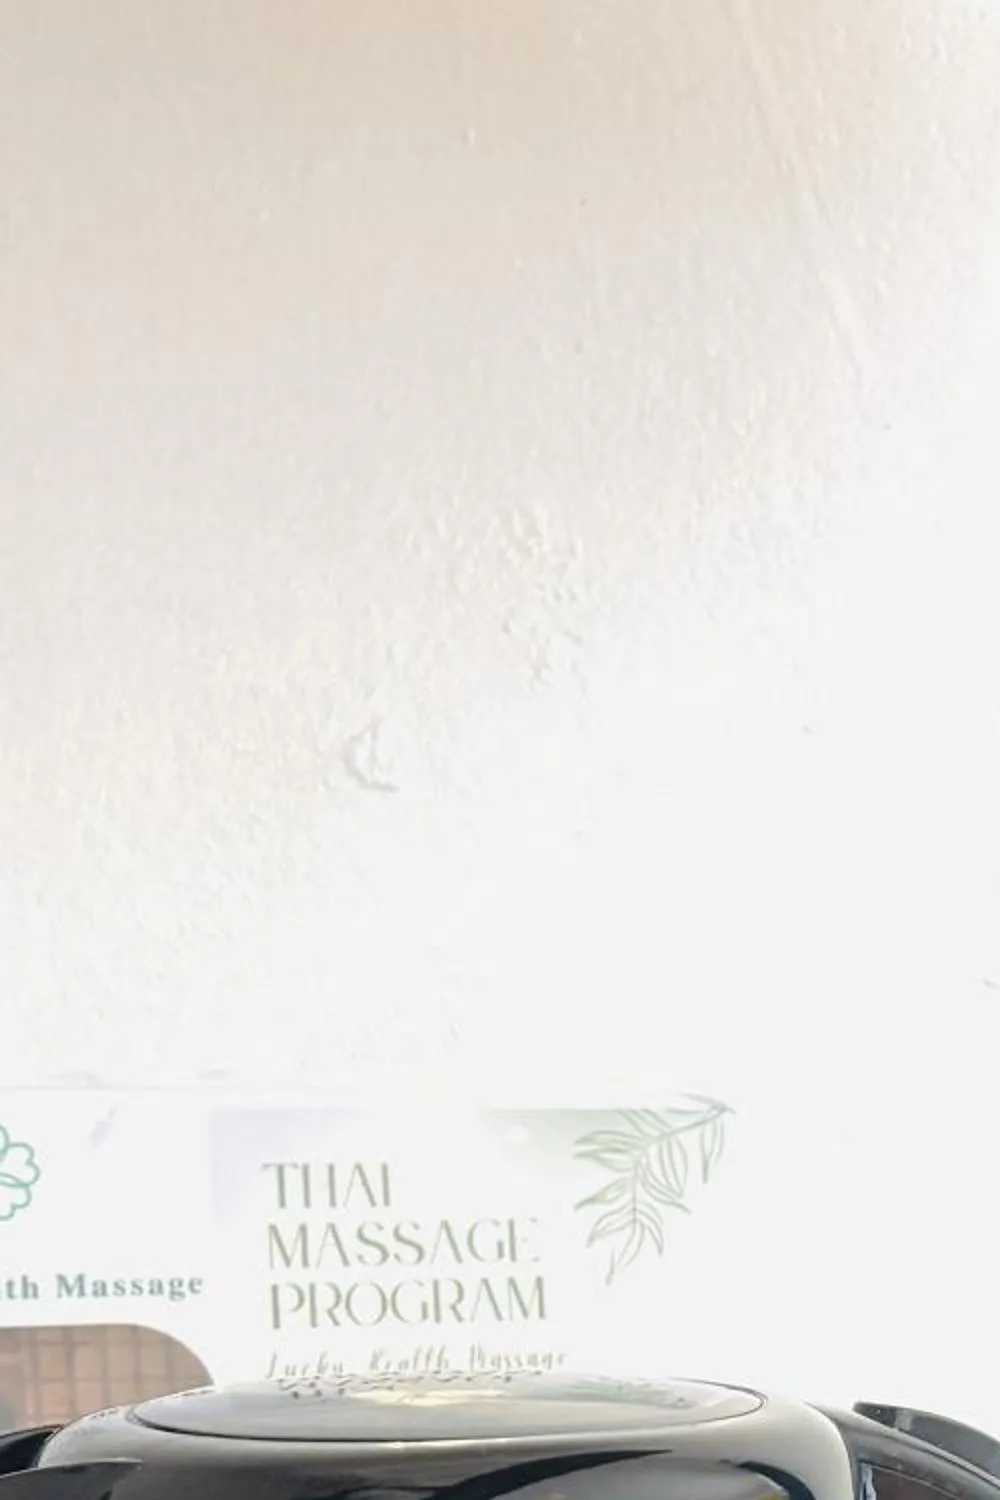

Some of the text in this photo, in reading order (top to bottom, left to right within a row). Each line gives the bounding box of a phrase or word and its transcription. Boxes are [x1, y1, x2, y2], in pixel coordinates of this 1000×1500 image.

[262, 1161, 394, 1210] THAI
[267, 1217, 542, 1271] MASSAGE
[0, 1272, 204, 1302] th Massage
[269, 1276, 548, 1330] PROGRAM
